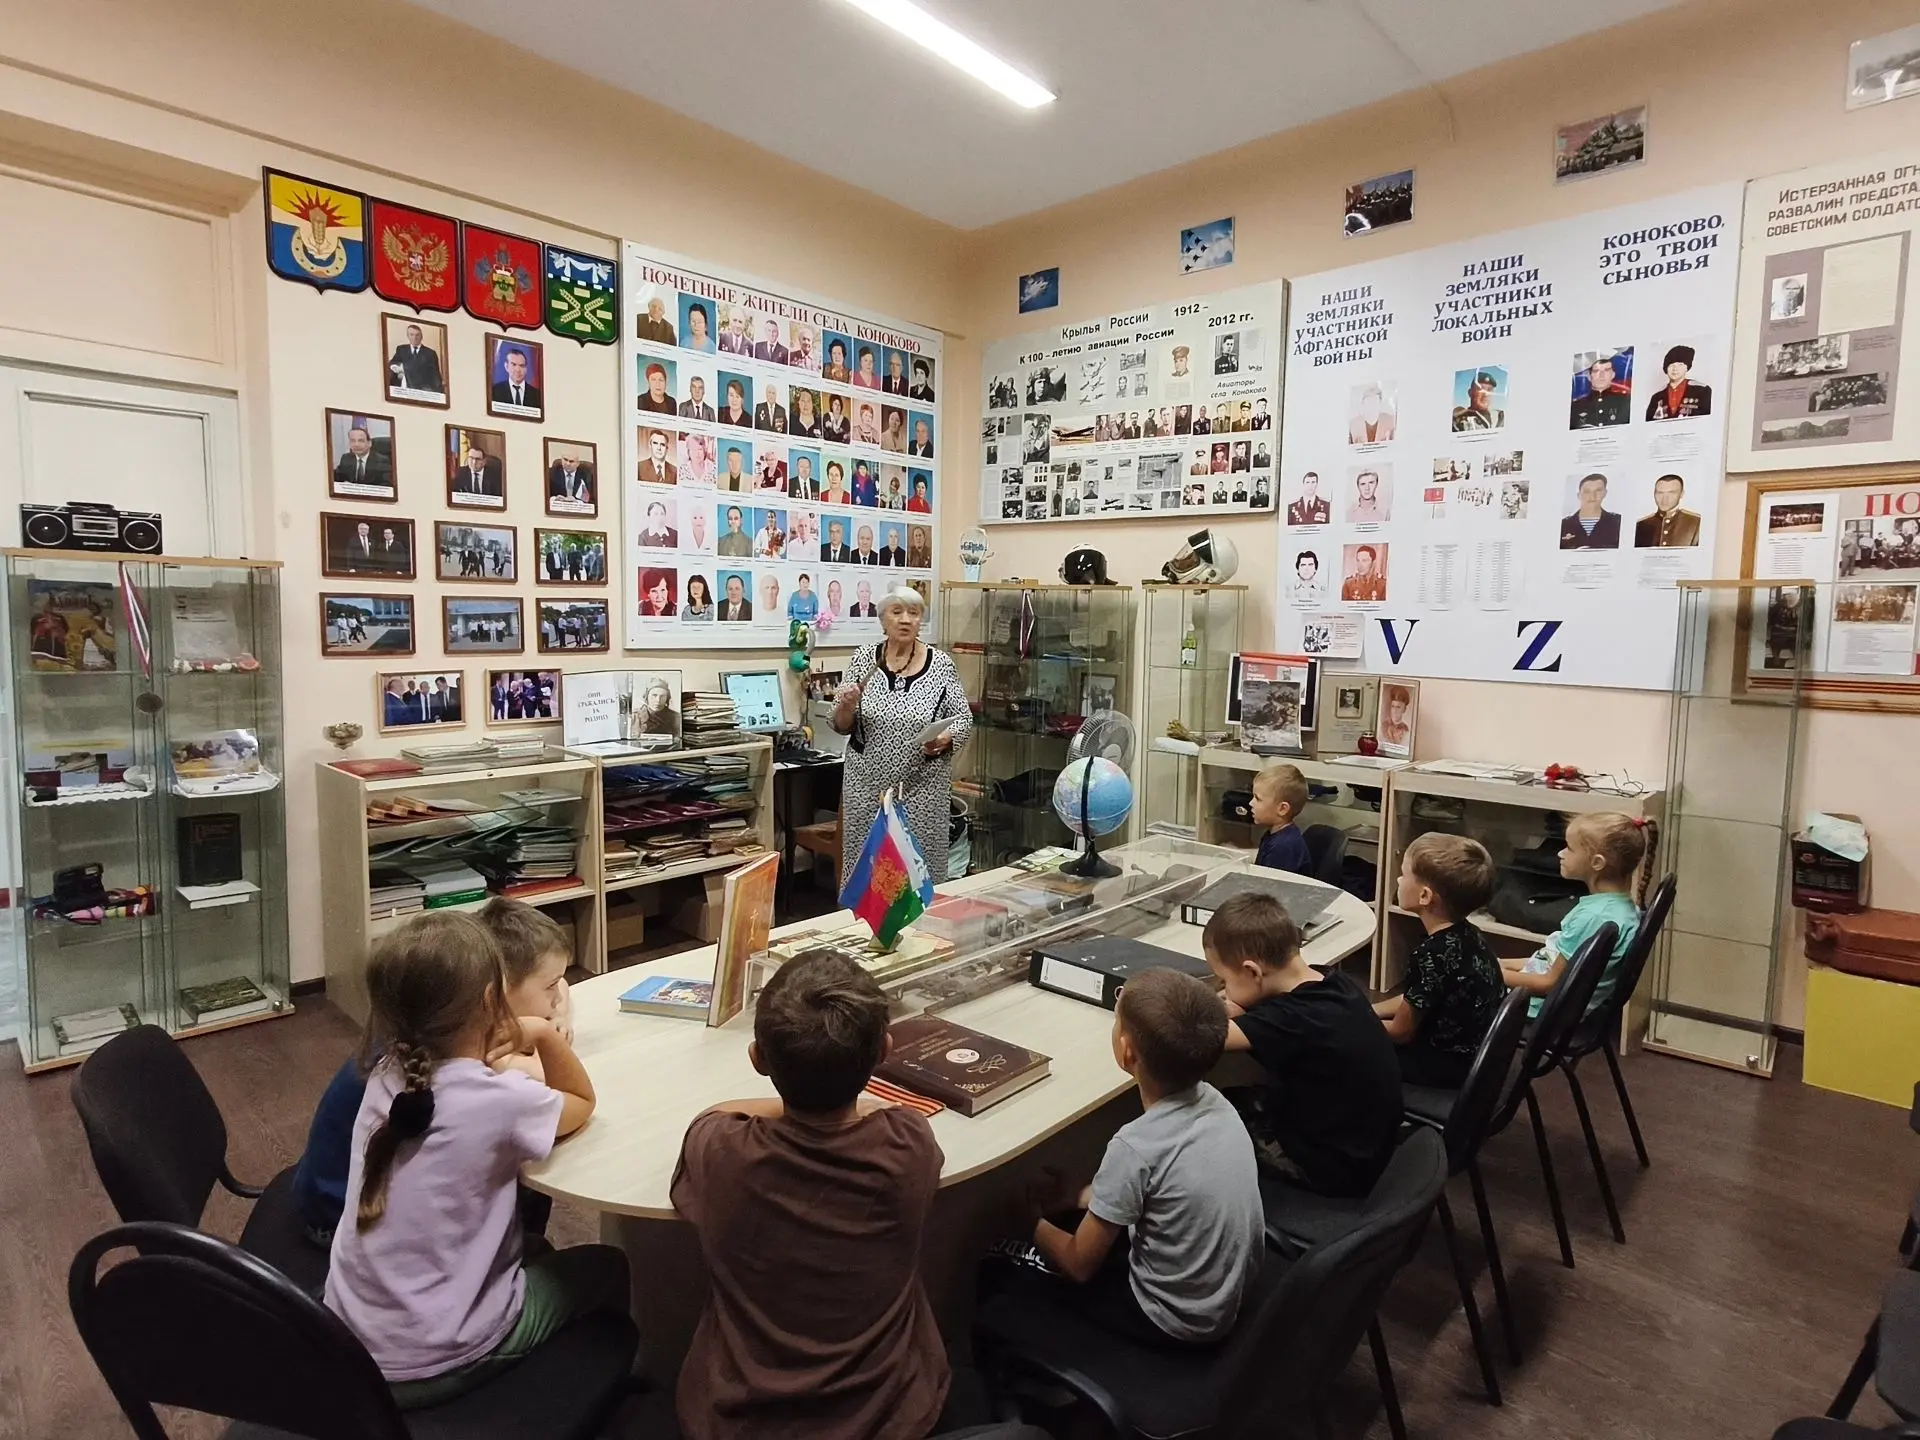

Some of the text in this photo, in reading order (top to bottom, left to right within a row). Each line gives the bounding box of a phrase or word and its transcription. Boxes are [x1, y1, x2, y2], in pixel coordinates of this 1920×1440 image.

[1768, 181, 1920, 222] РАЗВАЛИН ПРЕДСТА
[1602, 214, 1725, 251] КОНОКОВО,
[1766, 212, 1848, 238] СОВЕТСКИМ
[1462, 253, 1524, 277] НАШИ
[1599, 233, 1719, 269] ЭТО ТВОИ
[1602, 253, 1710, 286] СЫНОВЬЯ
[641, 264, 921, 354] ПОЧЕТНЫЕ ЖИТЕЛИ СЕЛА КОНОКОВО
[1320, 284, 1373, 306] НАШИ
[1174, 303, 1200, 317] 1912
[1208, 312, 1254, 328] 2012 гг.
[1431, 300, 1553, 333] ЛОКАЛЬНЫХ
[1061, 312, 1150, 341] Крылья России
[1461, 323, 1513, 344] ВОЙН
[1018, 355, 1026, 365] К
[1027, 352, 1044, 363] 100
[1051, 344, 1082, 359] летию
[1087, 336, 1130, 352] авиации
[1135, 327, 1175, 343] России
[1293, 327, 1388, 356] АФГАНСКОЙ
[1312, 346, 1373, 367] ВОЙНЫ
[1210, 386, 1267, 399] села Коноково
[1216, 379, 1256, 389] Авиаторы
[1374, 617, 1420, 665] V
[1512, 620, 1564, 672] Z
